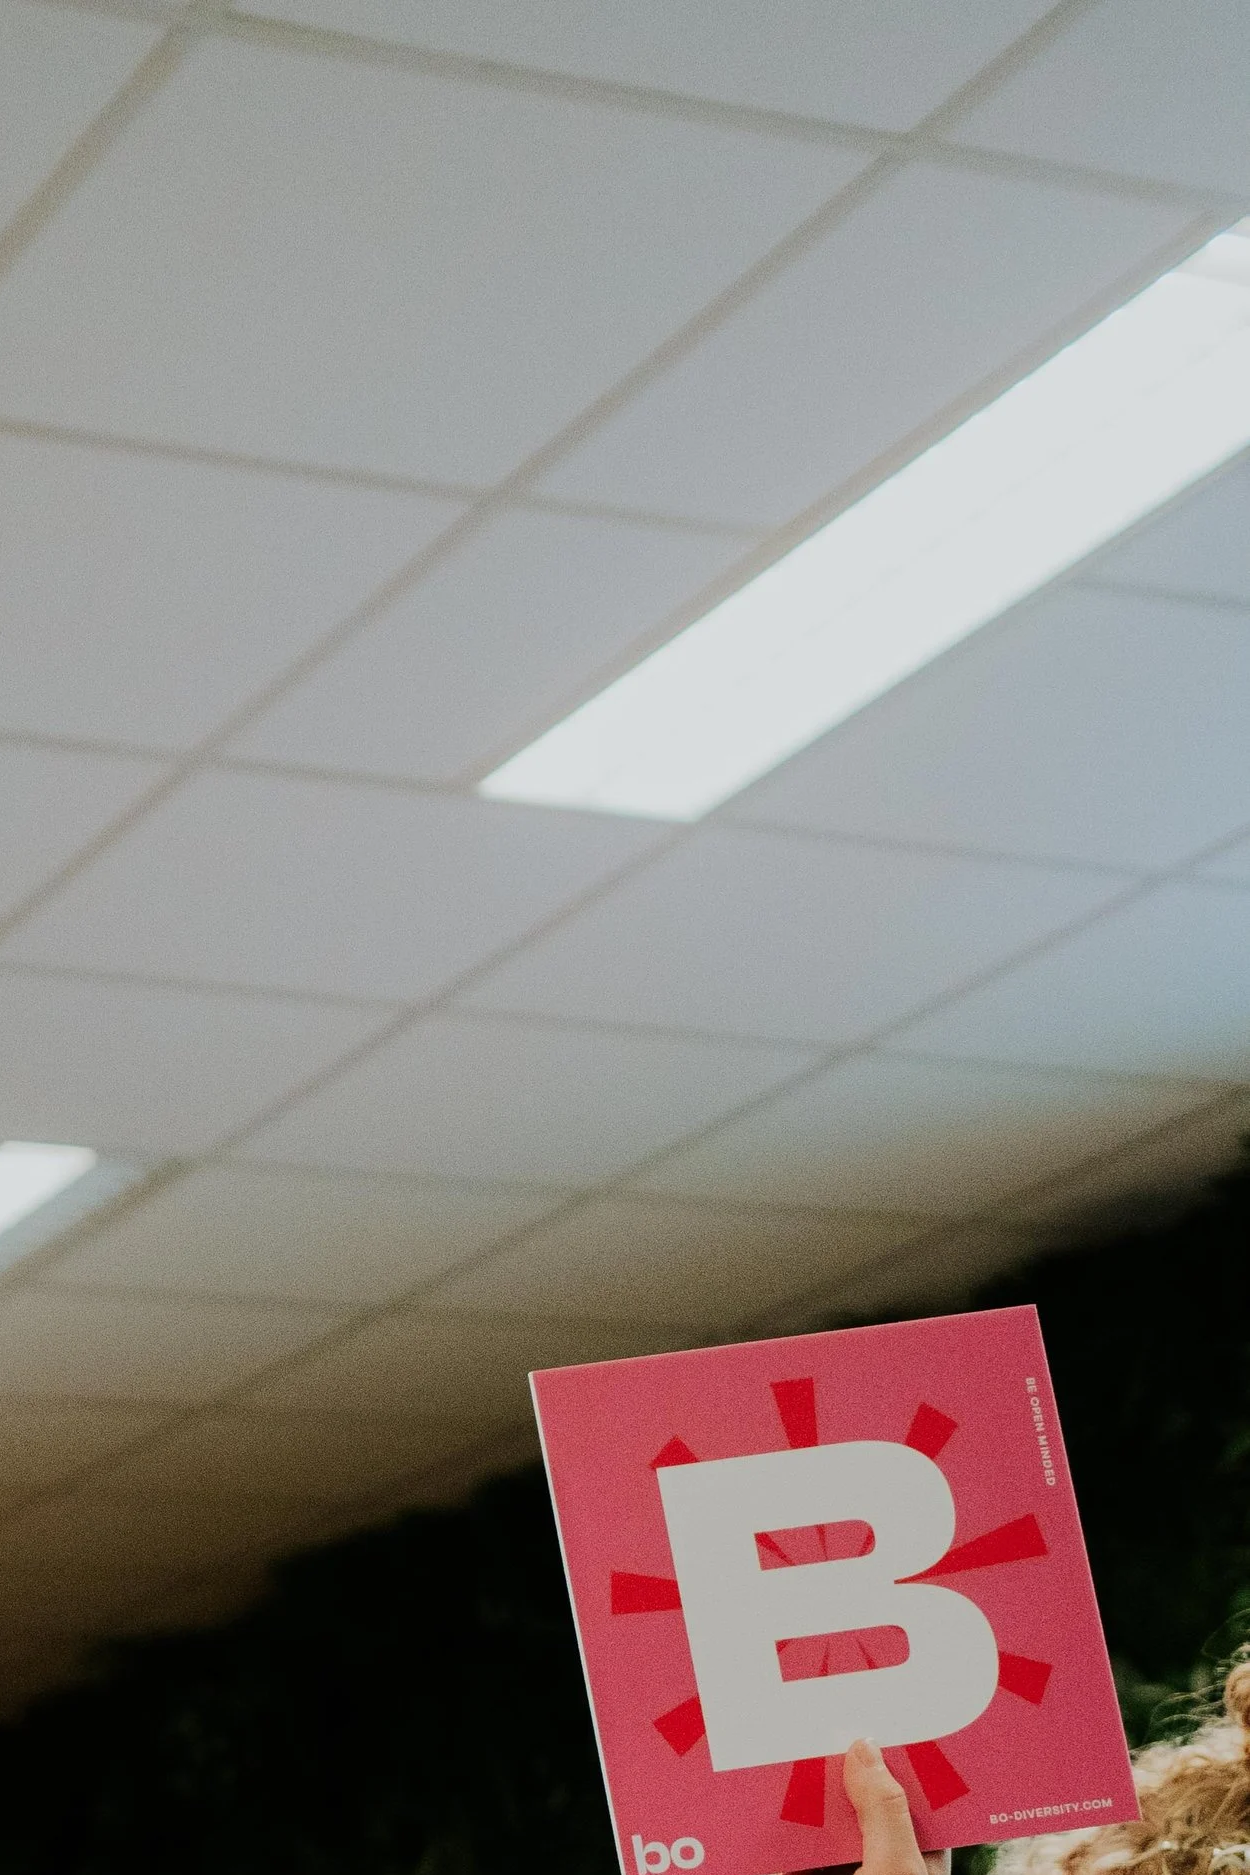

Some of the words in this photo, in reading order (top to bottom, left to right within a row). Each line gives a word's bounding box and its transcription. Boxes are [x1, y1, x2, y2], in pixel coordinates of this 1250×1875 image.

[1026, 1377, 1037, 1393] BE
[1030, 1397, 1045, 1432] OPEN
[1038, 1435, 1056, 1486] MINDED
[657, 1440, 999, 1773] B
[990, 1798, 1112, 1824] BO-DIVERSITY.COM
[632, 1834, 705, 1875] bo
